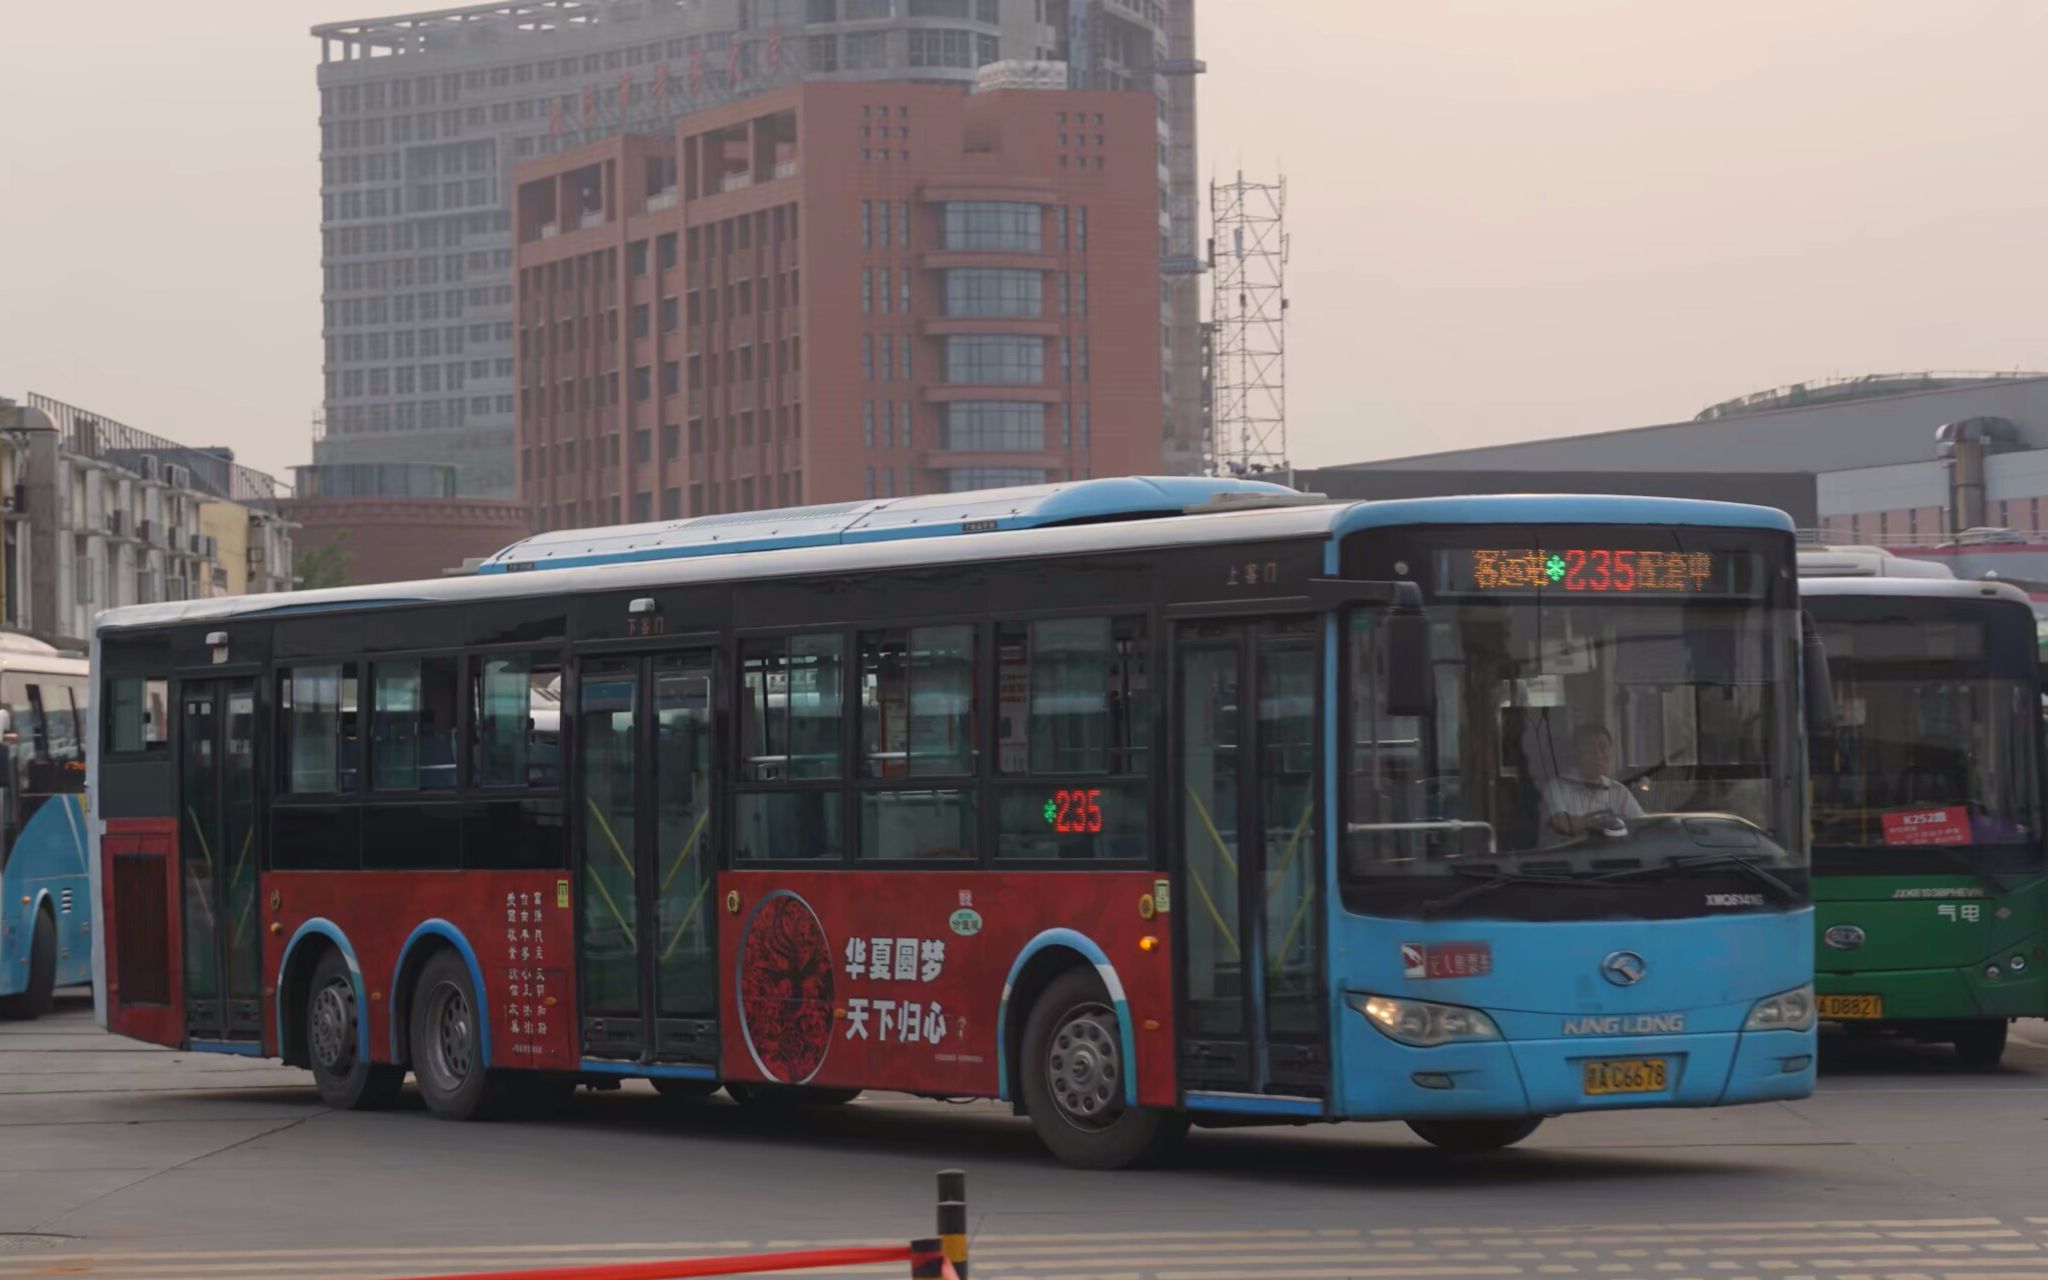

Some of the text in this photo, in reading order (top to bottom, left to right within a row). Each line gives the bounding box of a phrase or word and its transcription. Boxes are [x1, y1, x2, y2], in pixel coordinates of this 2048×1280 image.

[1226, 560, 1277, 585] 上客门
[1563, 549, 1634, 591] 235
[1056, 789, 1103, 832] 235
[1936, 904, 1981, 922] 气电
[844, 937, 946, 983] 华夏圆梦
[844, 997, 948, 1046] 天下归心
[1563, 1013, 1684, 1035] KING LONG
